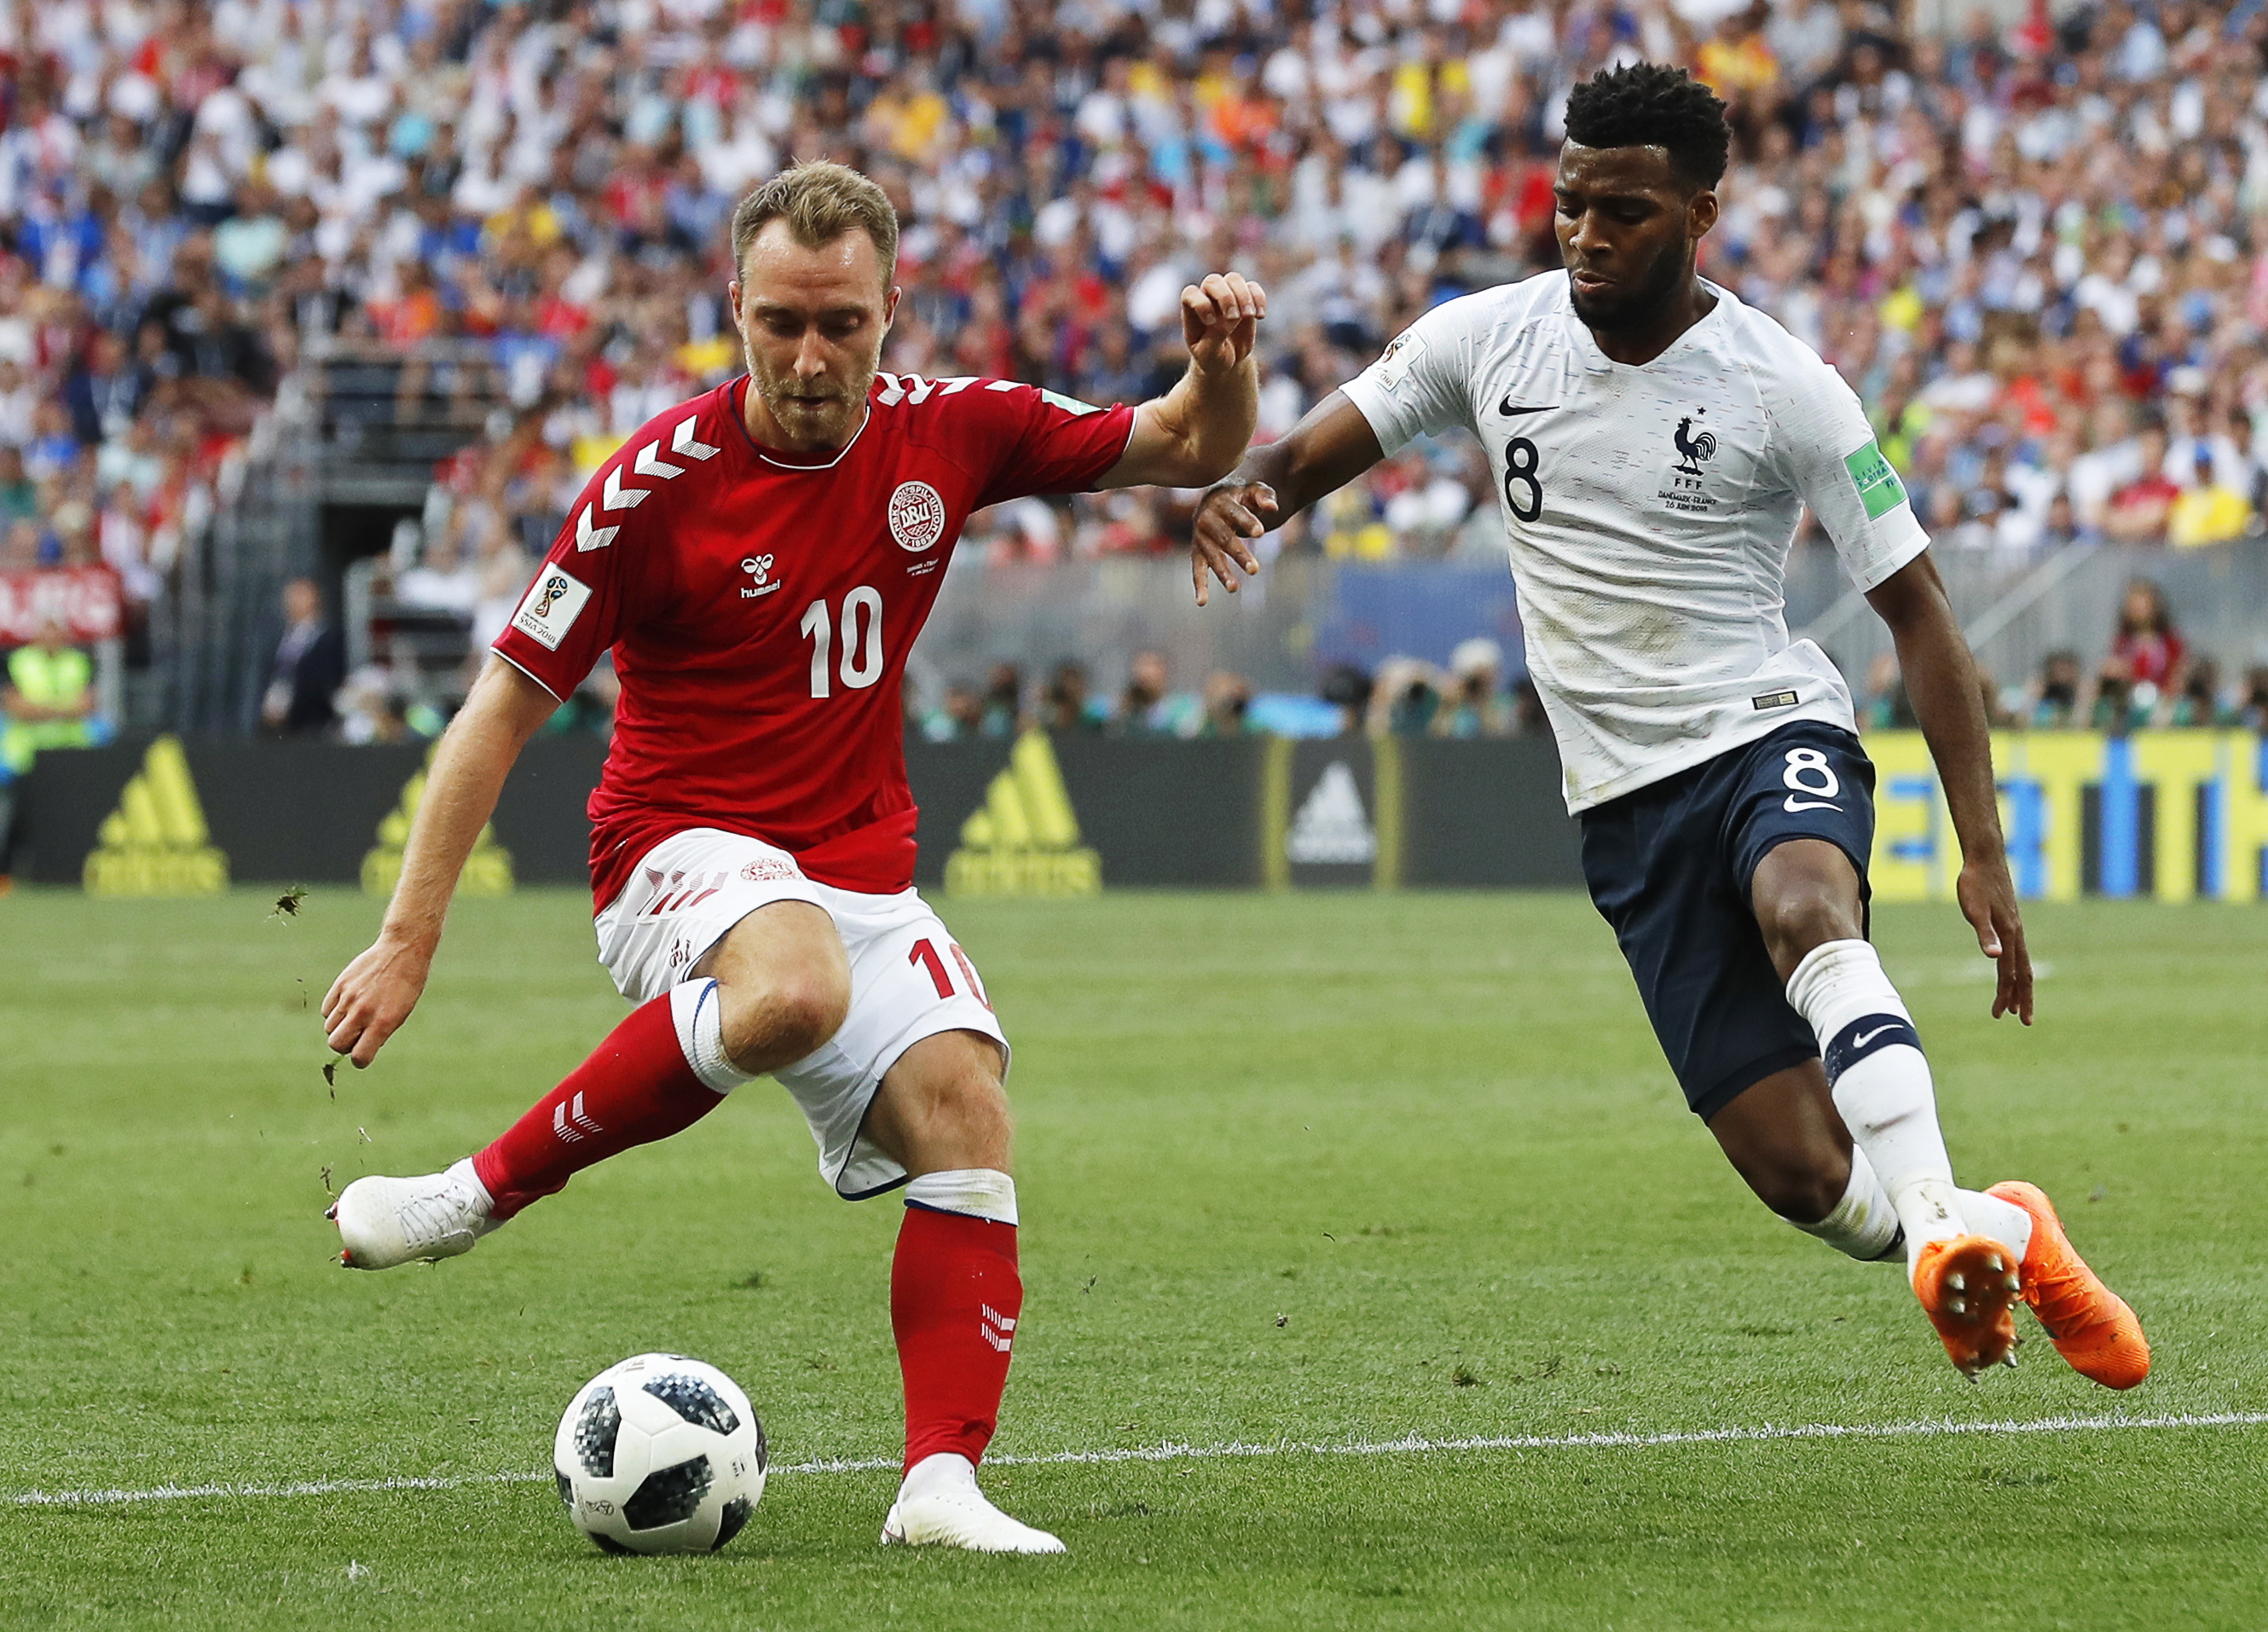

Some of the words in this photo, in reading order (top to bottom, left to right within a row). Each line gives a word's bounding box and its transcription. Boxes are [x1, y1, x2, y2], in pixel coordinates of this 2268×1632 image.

[1505, 437, 1542, 523] 8
[900, 502, 932, 529] DBU
[741, 579, 781, 599] hummel
[801, 586, 883, 698] 10
[1783, 747, 1839, 798] 8
